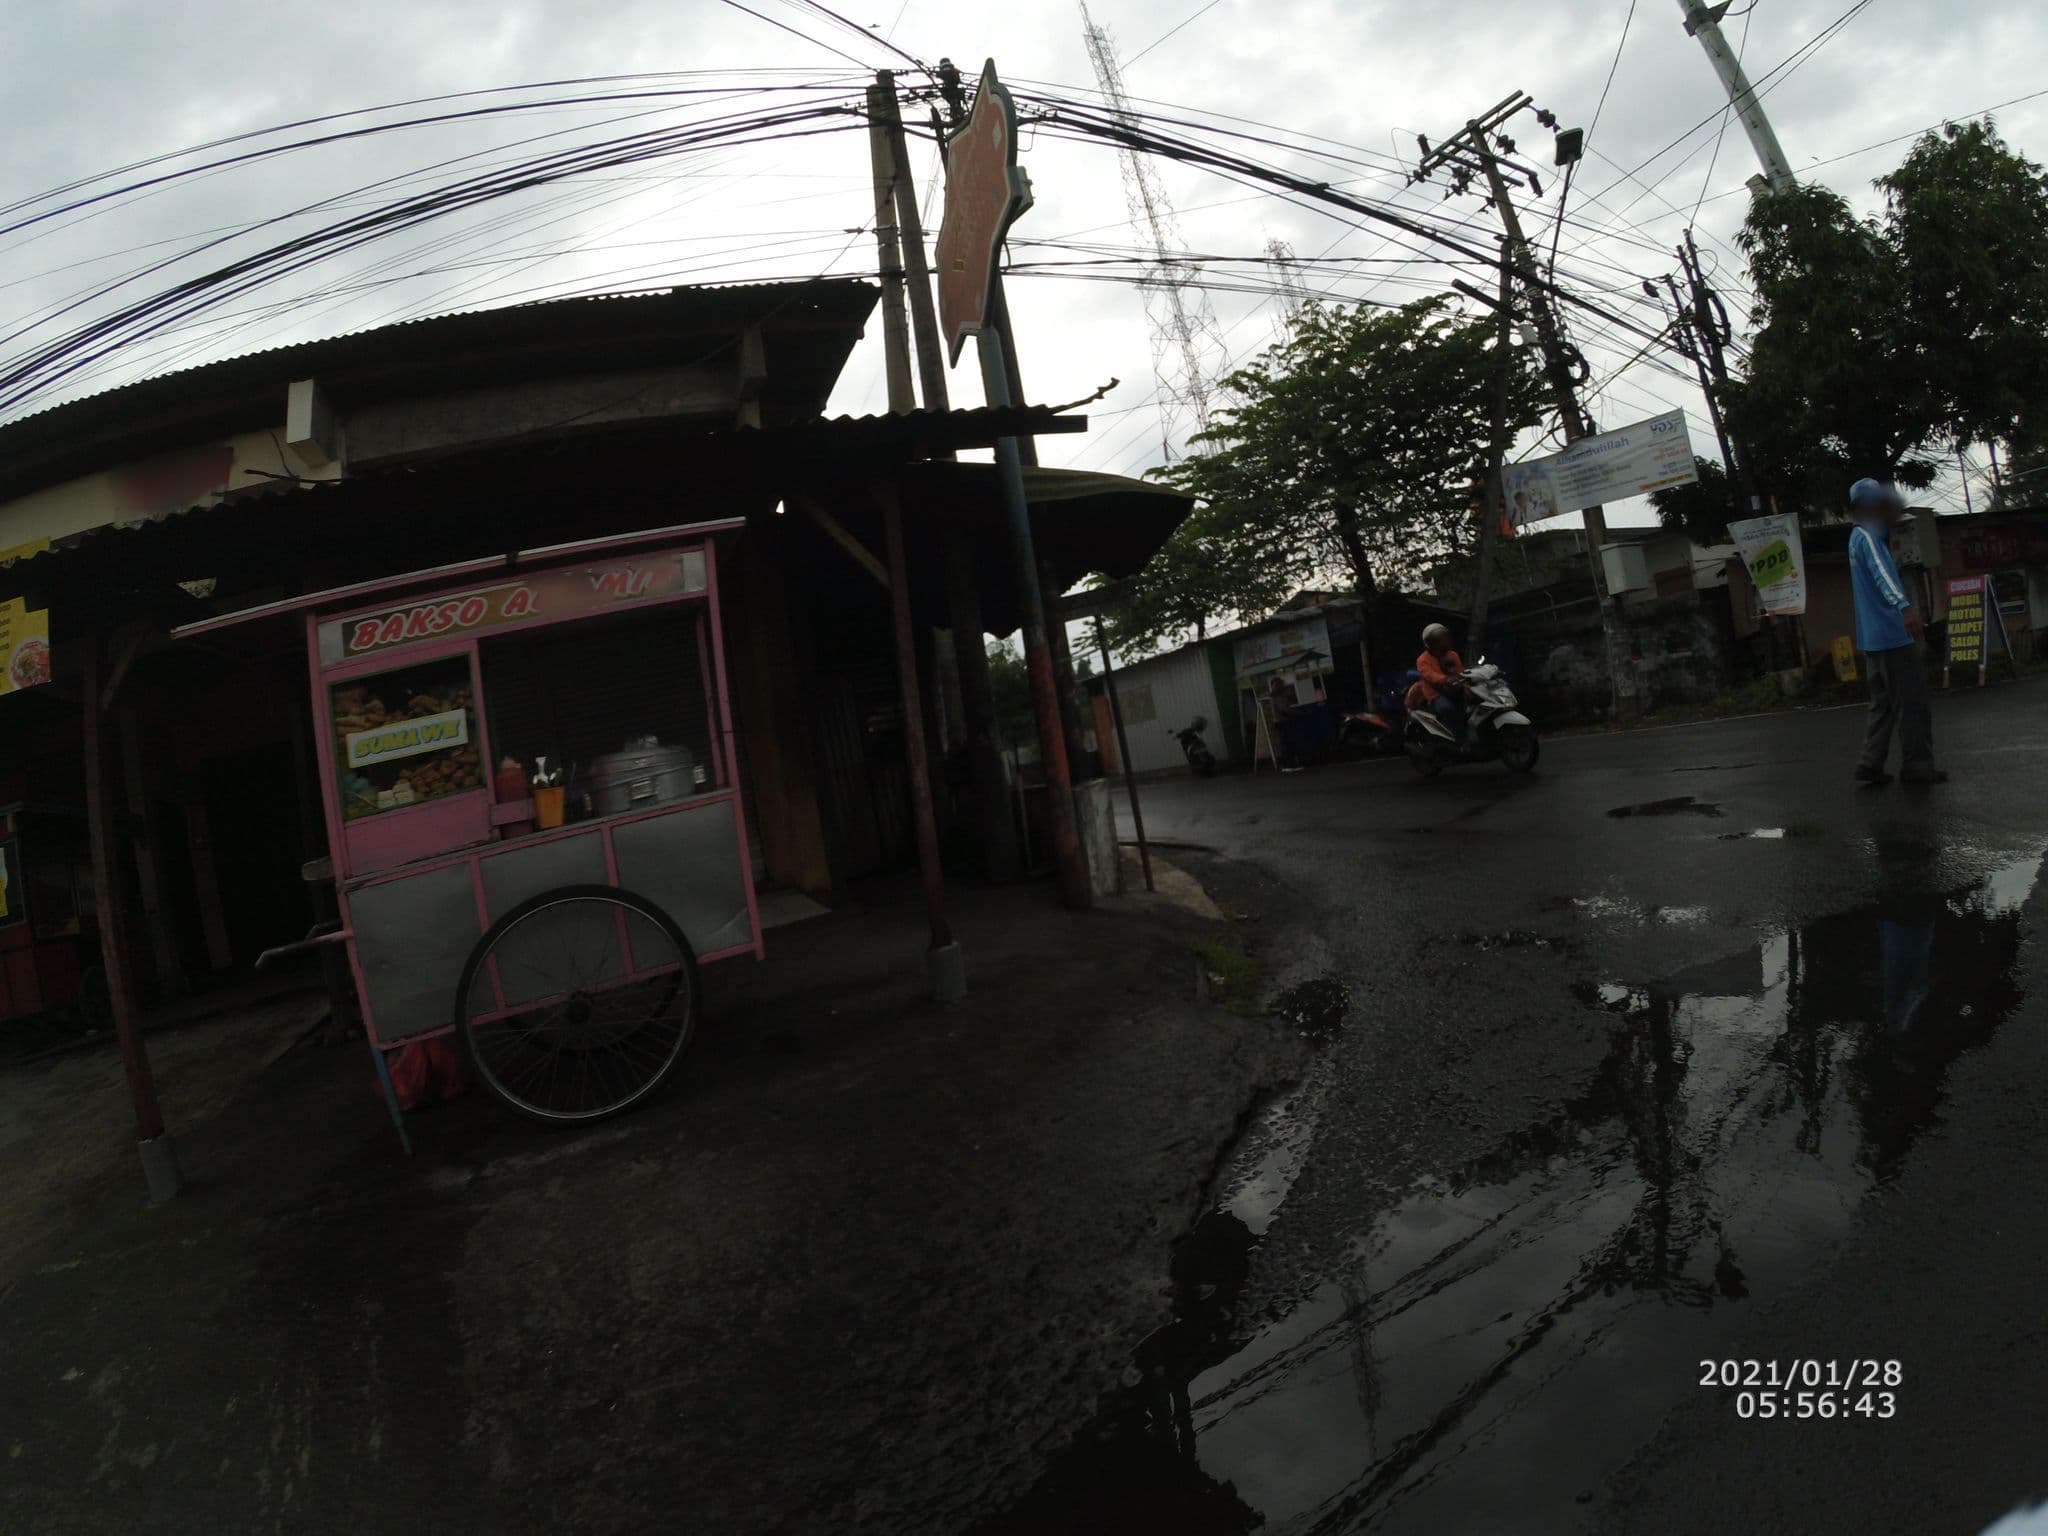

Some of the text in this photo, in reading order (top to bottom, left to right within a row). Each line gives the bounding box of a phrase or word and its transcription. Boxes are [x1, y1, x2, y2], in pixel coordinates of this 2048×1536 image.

[1949, 607, 1982, 620] MOTOR
[350, 596, 488, 650] BAKSO
[1948, 621, 1984, 635] KARPET
[1950, 635, 1980, 648] SALON
[1951, 648, 1980, 661] POLES
